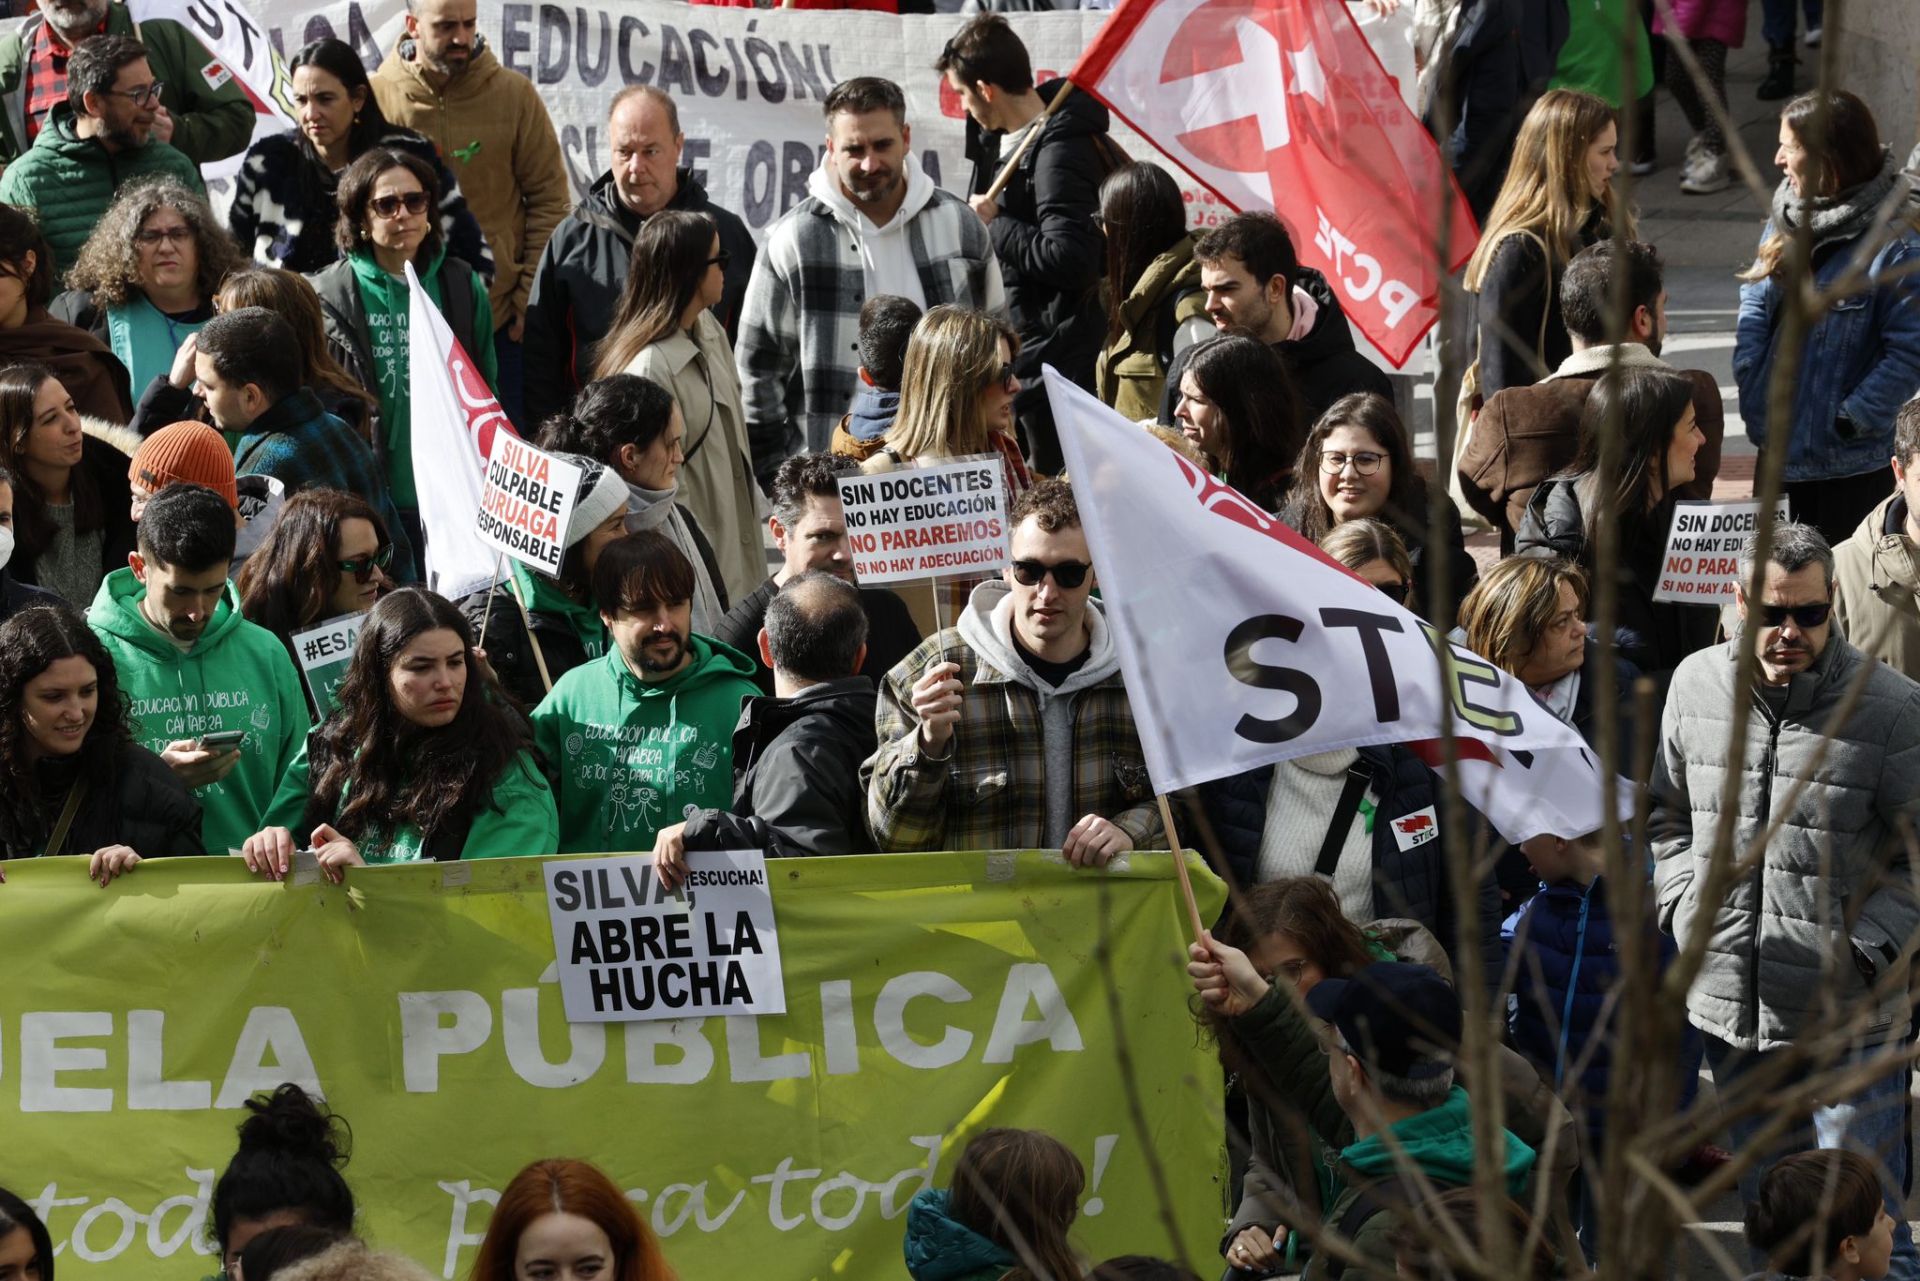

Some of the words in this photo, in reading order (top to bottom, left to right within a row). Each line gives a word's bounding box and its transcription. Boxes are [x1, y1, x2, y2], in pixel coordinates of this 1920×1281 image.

[502, 440, 549, 485] SILVA
[489, 459, 564, 515] CULPABLE
[841, 483, 875, 506] SIN
[880, 469, 993, 501] DOCENTES
[482, 482, 557, 543] BURUAGA
[845, 511, 867, 528] NO
[870, 506, 899, 526] HAY
[904, 493, 997, 522] EDUCACIÓN
[1677, 515, 1707, 532] SIN
[477, 506, 560, 566] RESPONSABLE
[850, 534, 877, 554] NO
[881, 518, 1002, 551] PARAREMOS
[1671, 538, 1692, 551] NO
[1695, 538, 1720, 552] HAY
[856, 562, 867, 575] SI
[870, 560, 888, 574] NO
[891, 557, 915, 572] HAY
[919, 545, 1004, 570] ADECUACIÓN
[1666, 557, 1692, 574] NO
[1662, 580, 1674, 592] SI
[1676, 582, 1694, 593] NO
[1696, 582, 1720, 594] HAY
[685, 869, 764, 891] ¡ESCUCHA!
[571, 916, 694, 965] ABRE
[704, 910, 763, 956] LA
[589, 960, 754, 1012] HUCHA
[0, 1006, 326, 1113] ELA
